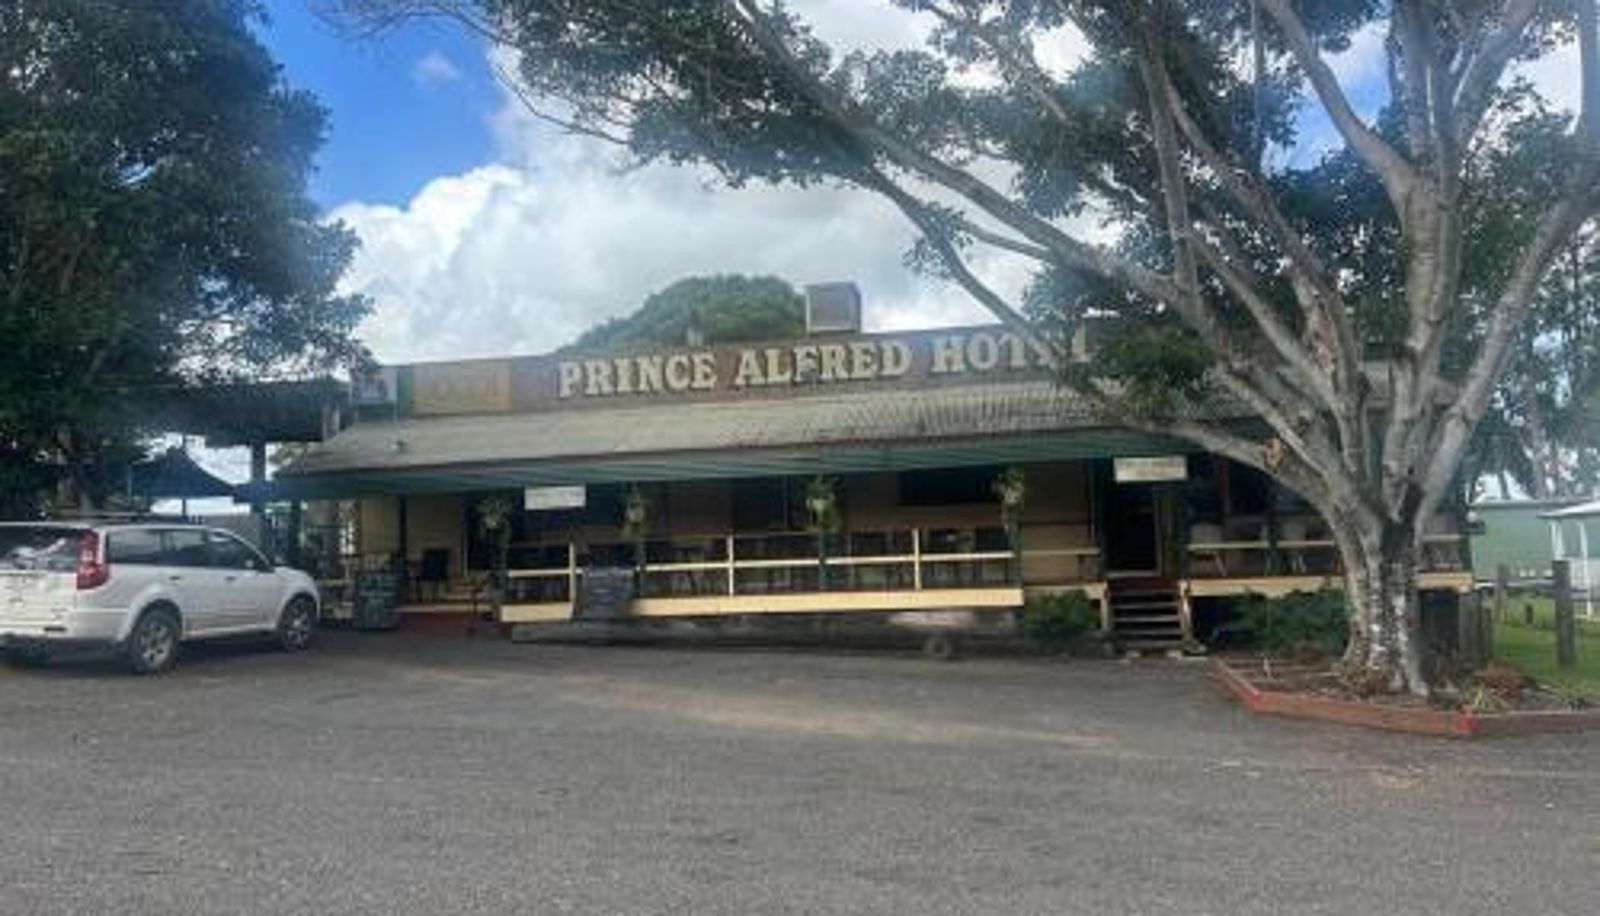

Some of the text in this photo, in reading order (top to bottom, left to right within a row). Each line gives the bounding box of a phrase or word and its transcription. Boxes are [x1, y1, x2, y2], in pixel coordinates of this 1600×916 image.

[558, 324, 1096, 399] PRINCE ALFRED HOTL
